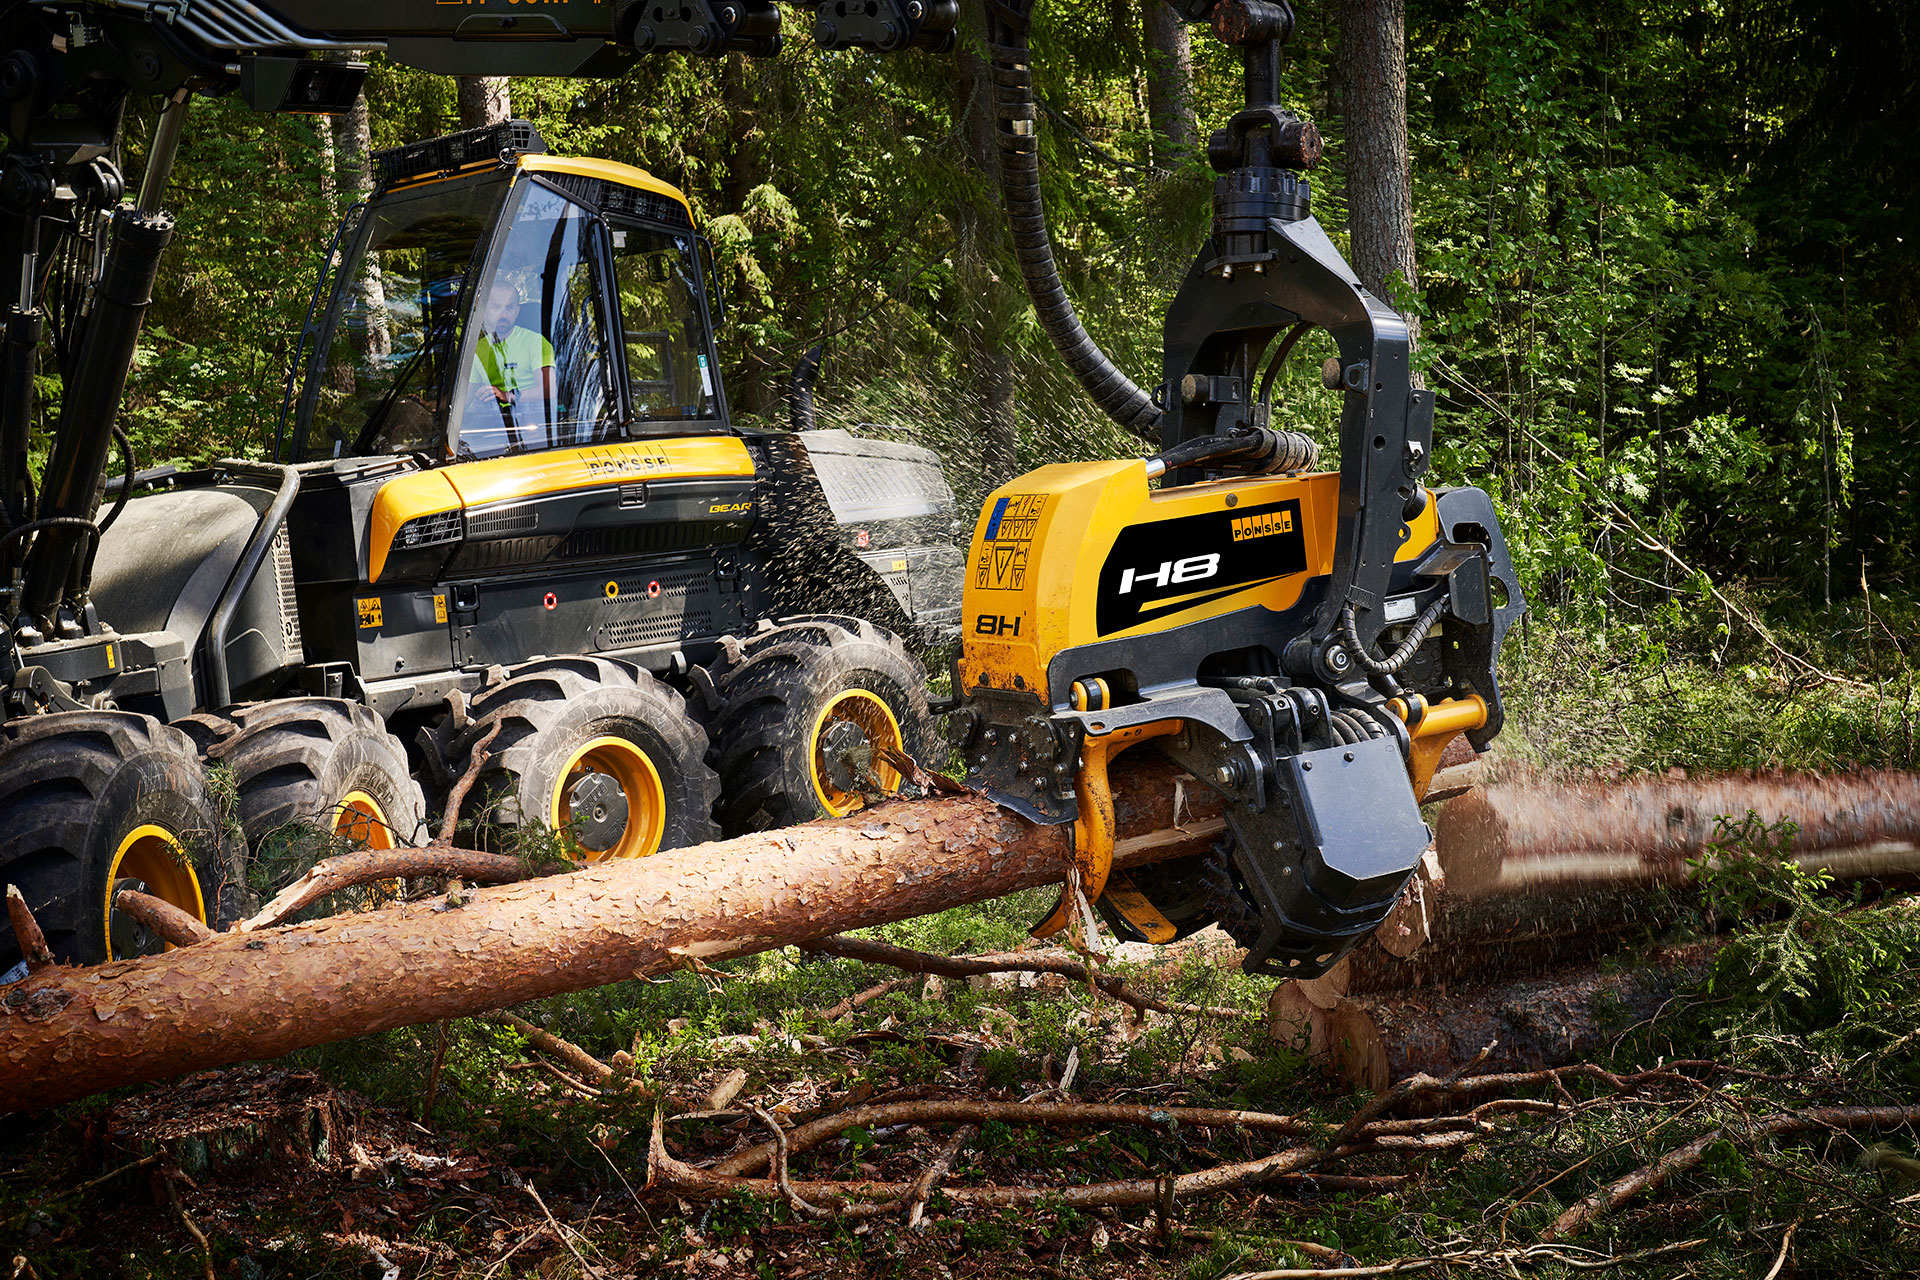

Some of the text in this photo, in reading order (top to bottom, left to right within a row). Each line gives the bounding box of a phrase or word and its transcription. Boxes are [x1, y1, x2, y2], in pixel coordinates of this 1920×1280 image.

[590, 457, 668, 475] PONSSE
[709, 503, 752, 514] BEAR
[1233, 520, 1292, 539] PONSSE
[1118, 552, 1221, 595] H8
